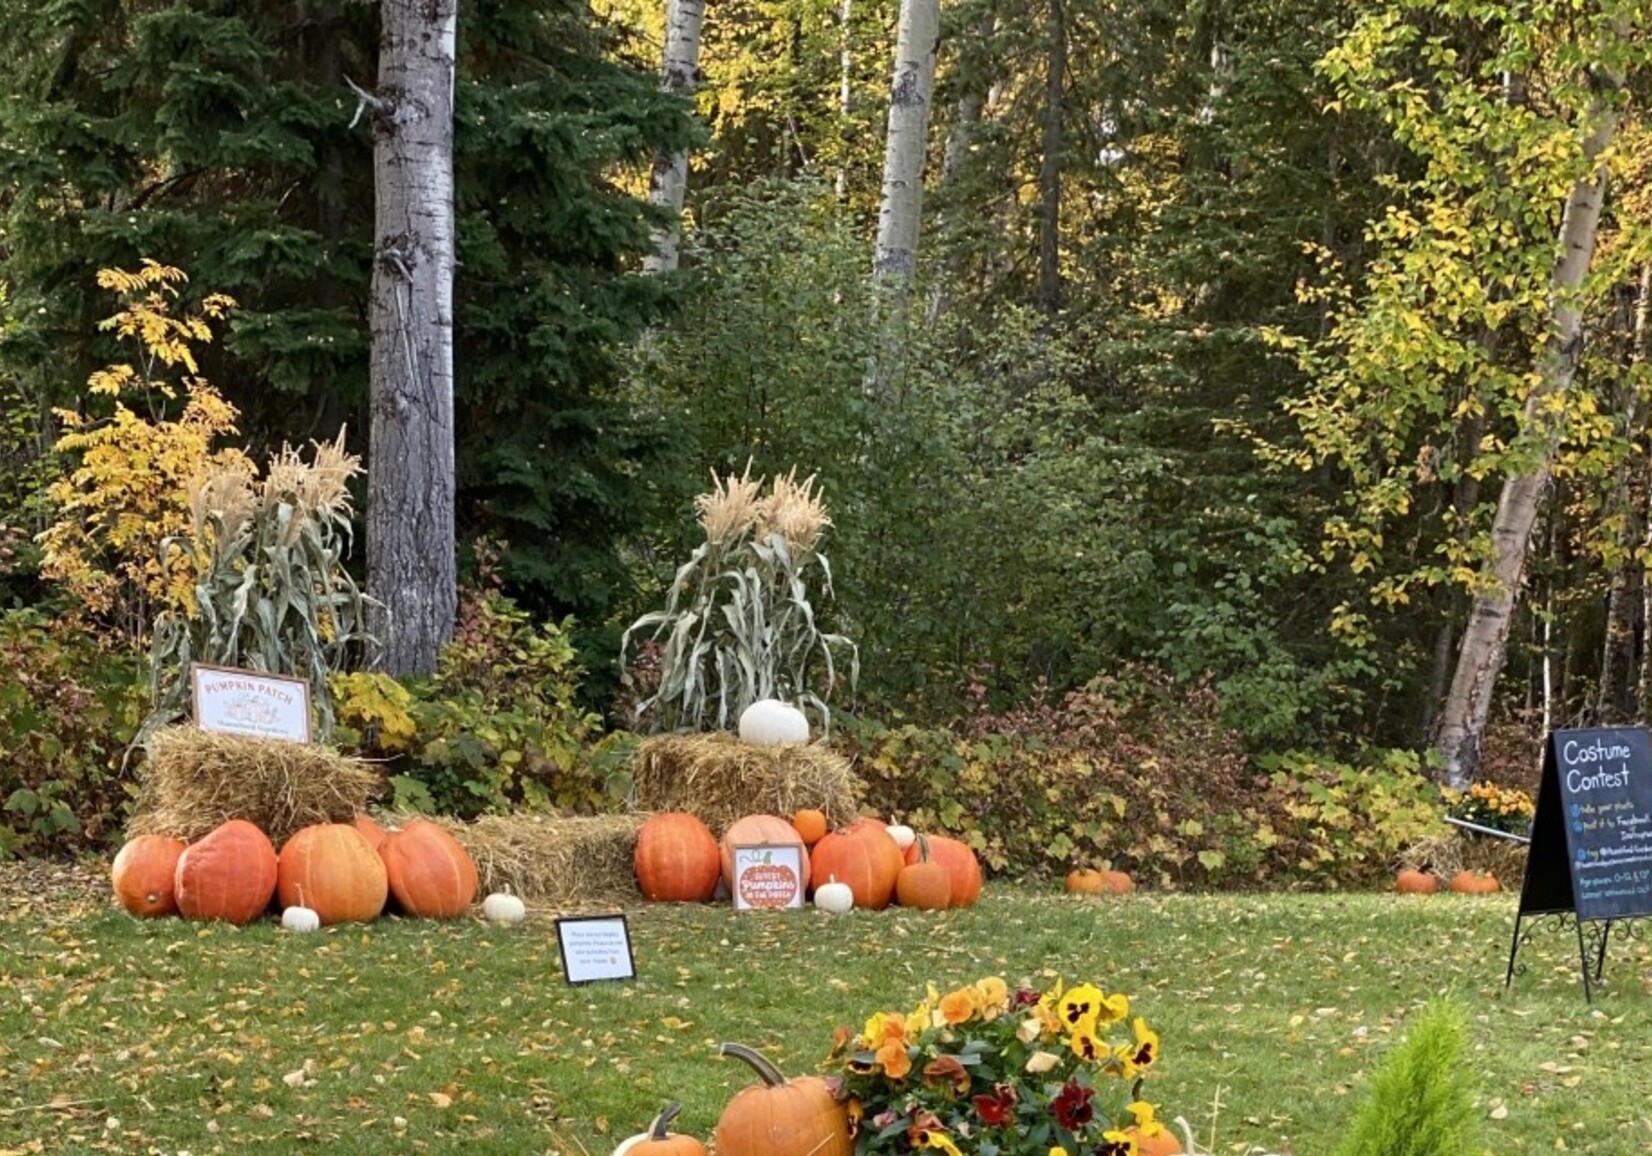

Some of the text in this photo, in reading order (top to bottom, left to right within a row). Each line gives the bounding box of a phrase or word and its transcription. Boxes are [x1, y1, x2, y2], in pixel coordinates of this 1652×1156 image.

[204, 680, 293, 705] PUMPKIN PATCH
[1563, 737, 1632, 765] Costume
[1567, 763, 1631, 794] Contest
[741, 880, 796, 892] Pumpkins
